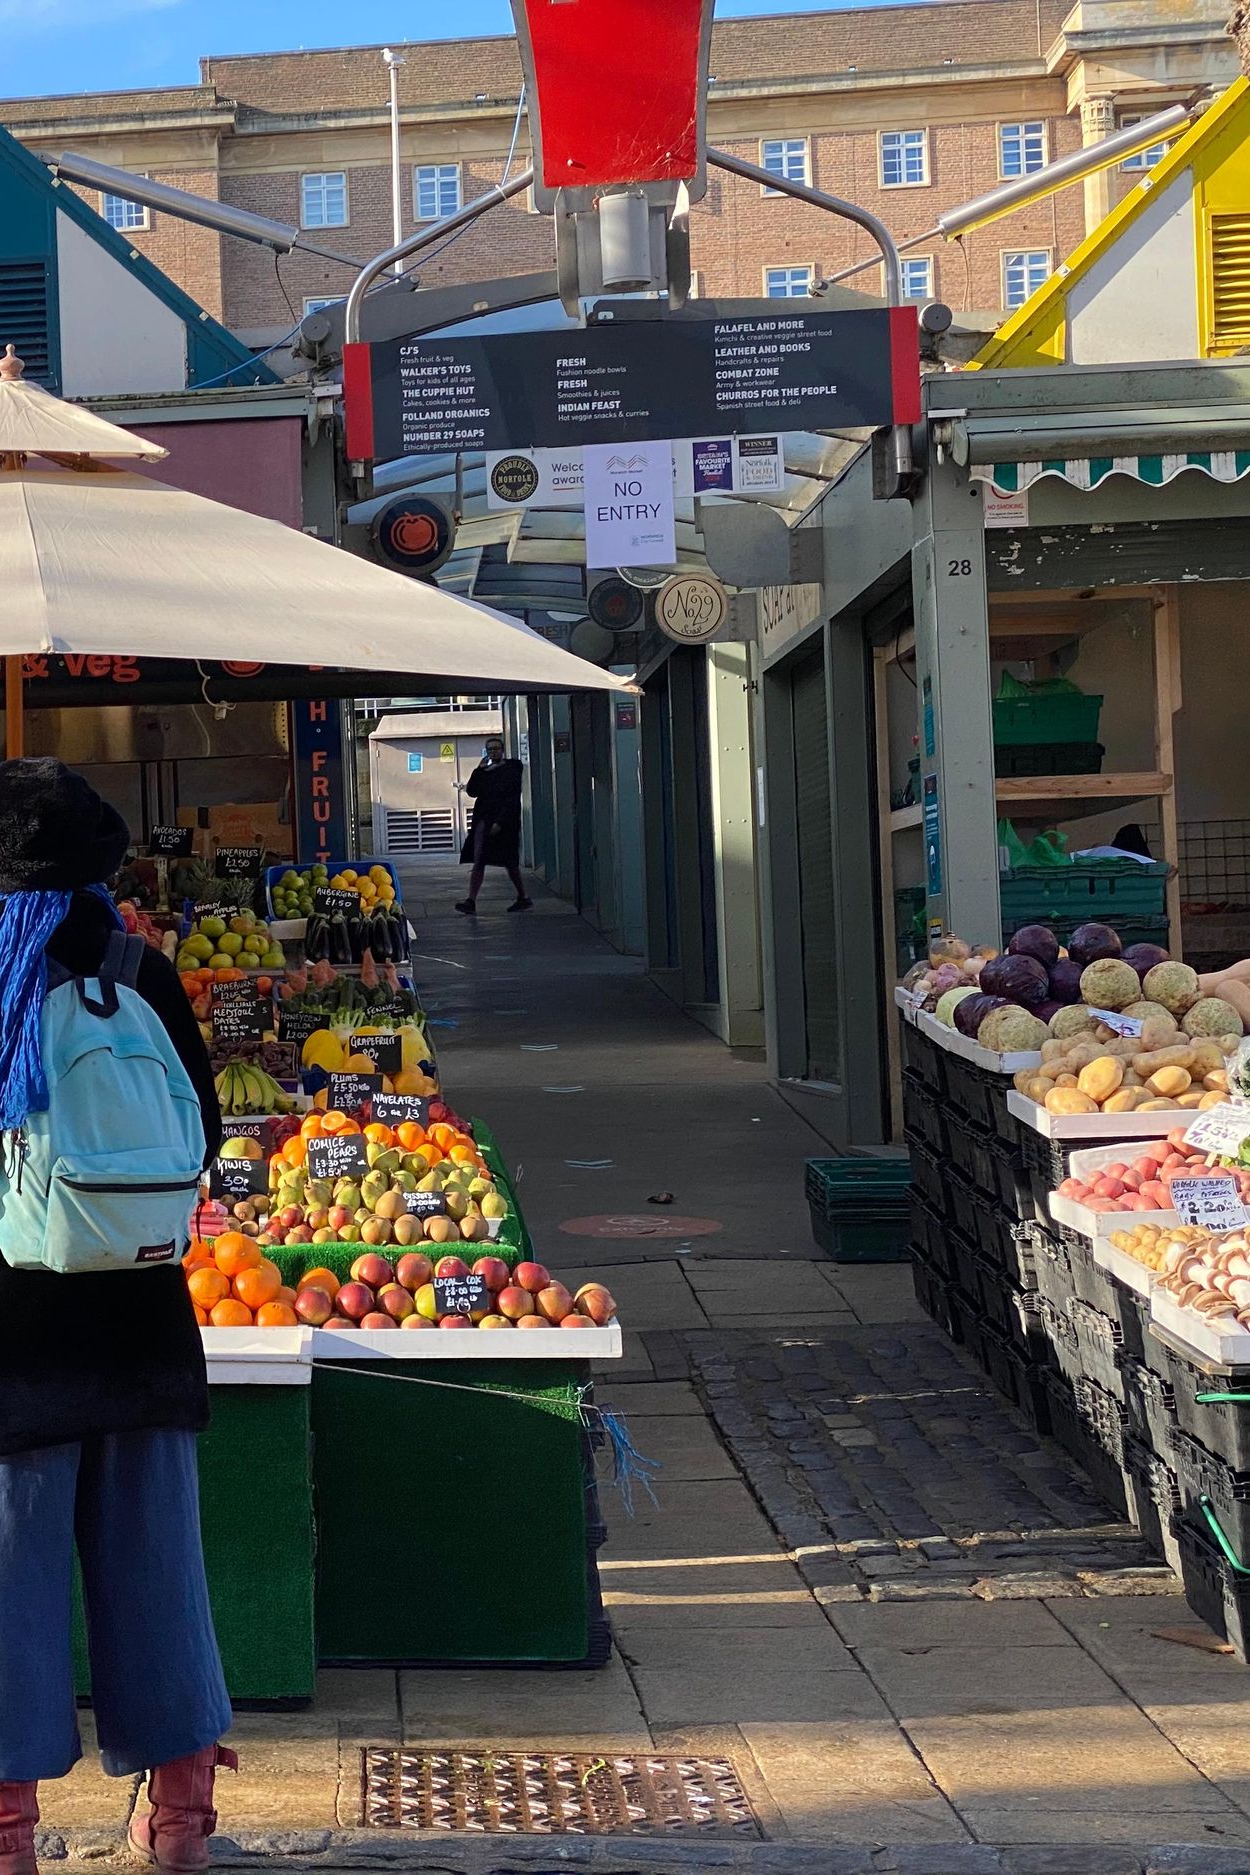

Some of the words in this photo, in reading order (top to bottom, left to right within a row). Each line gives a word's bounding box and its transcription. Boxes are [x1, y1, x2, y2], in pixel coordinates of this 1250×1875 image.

[715, 324, 755, 333] FALAFEL
[756, 322, 776, 331] AND
[778, 321, 804, 330] MORE
[747, 333, 772, 341] creative
[774, 332, 795, 341] veggie
[400, 347, 419, 355] CJ'S
[715, 347, 756, 357] LEATHER
[758, 345, 778, 354] AND
[780, 343, 810, 353] BOOKS
[556, 358, 586, 367] FRESH
[715, 358, 752, 366] Handcrafts
[761, 356, 784, 364] repairs
[401, 366, 447, 377] WALKER'S
[448, 365, 471, 374] TOYS
[716, 370, 753, 379] COMBAT
[755, 368, 779, 377] ZONE
[557, 380, 587, 389] FRESH
[403, 388, 420, 398] THE
[422, 387, 454, 397] CUPPIE
[456, 386, 474, 395] HUT
[557, 391, 592, 399] Smoothies
[600, 389, 620, 397] juices
[716, 390, 759, 400] CHURROS
[761, 388, 779, 398] FOR
[781, 387, 799, 397] THE
[801, 386, 837, 396] PEOPLE
[558, 403, 590, 412] INDIAN
[591, 401, 621, 410] FEAST
[717, 403, 743, 411] Spanish
[402, 411, 443, 421] FOLLAND
[445, 408, 490, 419] ORGANICS
[571, 413, 592, 421] veggie
[594, 411, 617, 419] snacks
[403, 423, 428, 431] Organic
[429, 422, 455, 430] produce
[403, 432, 441, 441] NUMBER
[443, 431, 454, 440] 29
[455, 429, 485, 438] SOAPS
[404, 441, 463, 451] Ethically-produced
[465, 440, 484, 448] soaps
[500, 460, 530, 473] PROUDLY
[699, 463, 726, 471] MARKET
[498, 474, 531, 483] NORFOLK
[615, 481, 642, 497] NO
[597, 504, 661, 522] ENTRY
[948, 559, 972, 577] 28
[66, 653, 141, 683] Veg
[311, 751, 331, 864] FRUIT
[153, 826, 186, 836] AVOCADOS
[216, 848, 259, 857] PINEAPPLES
[317, 887, 359, 899] AUBERGINE
[214, 905, 237, 915] APPLES
[367, 1003, 401, 1015] FENNEL
[214, 1017, 240, 1025] DATES
[350, 1036, 396, 1048] GRAPEFRUIT
[331, 1073, 359, 1083] PLUMS
[372, 1093, 423, 1107] NAVELATES
[376, 1105, 387, 1118] 6
[405, 1107, 420, 1120] £3
[308, 1137, 346, 1152] COMICE
[327, 1145, 358, 1160] PEARS
[217, 1158, 252, 1176] KIWIS
[222, 1175, 250, 1188] 30p
[434, 1277, 464, 1288] LOCAL
